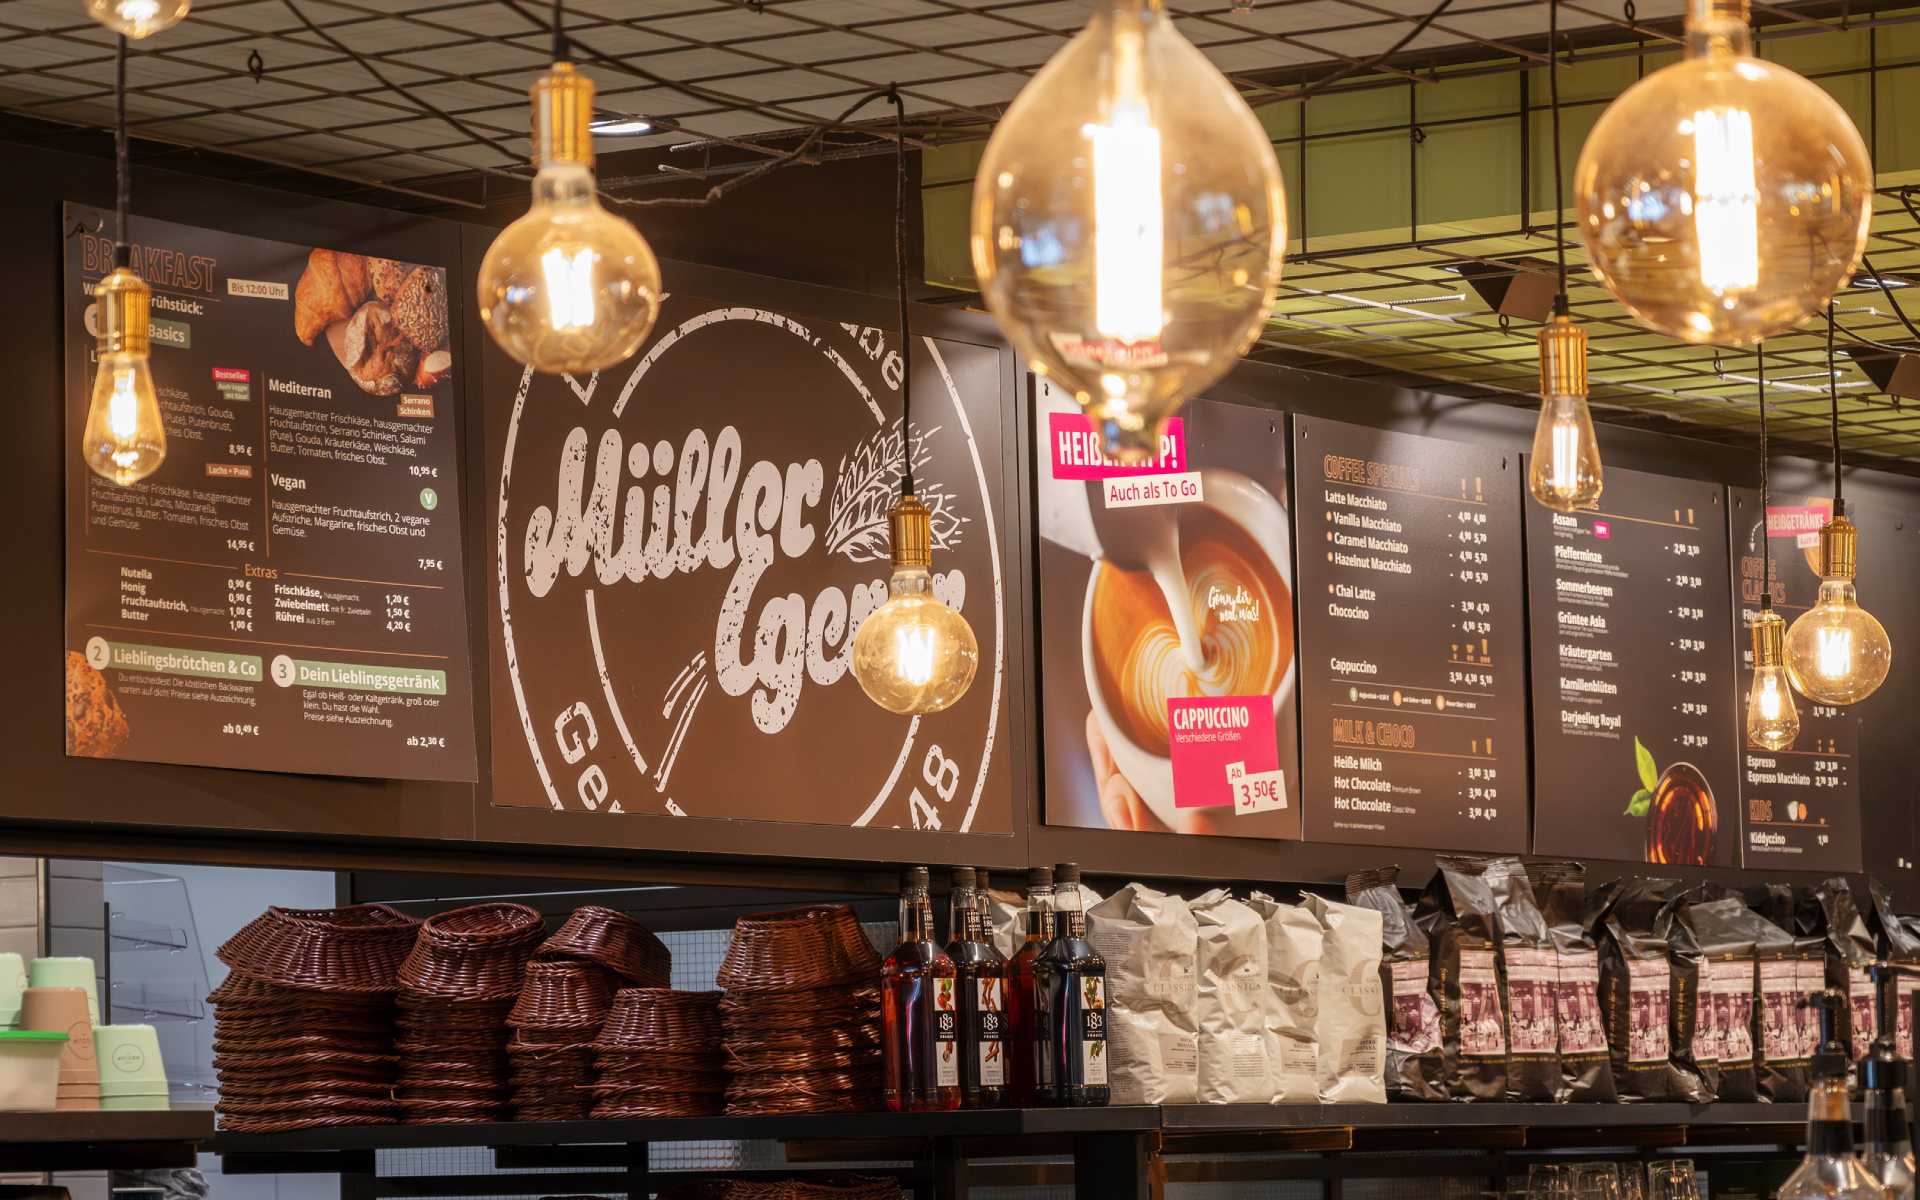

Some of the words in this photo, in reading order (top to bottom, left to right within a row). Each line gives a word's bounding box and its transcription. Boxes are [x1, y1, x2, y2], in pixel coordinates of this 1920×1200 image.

[80, 234, 216, 293] BRAKFAST
[232, 282, 244, 292] Bis
[246, 284, 267, 295] 12:00
[269, 287, 286, 296] Uhr
[149, 296, 204, 316] rühstück:
[148, 324, 185, 342] Basics
[268, 379, 332, 400] Mediterran
[403, 396, 431, 405] Serrano
[269, 405, 329, 423] Hausgemachter
[330, 412, 371, 427] Frischkäse,
[374, 416, 434, 434] hausgemachter
[400, 407, 432, 416] Schinken
[269, 418, 328, 434] Fruchtaufstrich,
[330, 424, 360, 438] Serrano
[362, 428, 398, 444] Schinken,
[400, 432, 426, 446] Salami
[229, 444, 246, 454] 8,95
[246, 446, 252, 456] €
[324, 436, 372, 452] Kräuterkäse,
[374, 442, 417, 458] Weichkäse,
[334, 450, 365, 464] frisches
[366, 454, 388, 466] Obst.
[409, 466, 430, 478] 10,95
[432, 467, 438, 478] €
[1324, 454, 1365, 484] COFFEE
[271, 474, 306, 492] Vegan
[1110, 483, 1140, 502] Auch
[1143, 482, 1160, 500] als
[1162, 481, 1178, 498] To
[1180, 480, 1197, 496] Go
[424, 493, 434, 504] V
[1325, 490, 1346, 504] Latte
[1347, 493, 1388, 511] Macchiato
[272, 498, 331, 516] hausgemachter
[332, 506, 393, 522] Fruchtaufstrich,
[394, 512, 400, 522] 2
[402, 515, 431, 528] vegane
[524, 425, 824, 597] Müller
[1553, 512, 1578, 528] Assam
[272, 512, 313, 526] Aufstriche,
[314, 518, 356, 532] Margarine,
[356, 522, 388, 534] frisches
[388, 524, 408, 536] Obst
[409, 526, 426, 538] und
[1334, 512, 1360, 526] Vanilla
[1362, 514, 1402, 533] Macchiato
[226, 539, 247, 550] 14,95
[248, 541, 255, 552] €
[1334, 532, 1367, 548] Caramel
[1368, 536, 1408, 554] Macchiato
[1335, 552, 1370, 568] Hazelnut
[1371, 556, 1412, 574] Macchiato
[1554, 545, 1602, 564] Pfefferminze
[244, 564, 278, 578] Extras
[418, 558, 435, 570] 7,95
[436, 560, 444, 570] €
[120, 567, 152, 580] Nutella
[246, 581, 252, 592] €
[1556, 578, 1613, 597] Sommerbeeren
[120, 581, 146, 596] Honig
[246, 594, 252, 604] €
[274, 584, 322, 600] Frischkäse,
[386, 594, 402, 606] 1,20
[403, 596, 409, 606] €
[1336, 584, 1354, 598] Chai
[1355, 586, 1376, 600] Latte
[121, 595, 189, 612] Fruchtaufstrich,
[246, 608, 252, 618] €
[274, 598, 330, 612] Zwiebelmett
[386, 608, 403, 619] 1,50
[404, 610, 410, 619] €
[1328, 603, 1370, 620] Chococino
[121, 608, 150, 622] Butter
[247, 622, 252, 632] €
[276, 612, 304, 624] Rührei
[386, 622, 404, 632] 4,20
[405, 622, 411, 632] €
[1558, 610, 1589, 627] Grüntee
[1590, 614, 1606, 628] Asia
[94, 646, 102, 662] 2
[114, 648, 226, 673] Lieblingsbrötchen
[228, 660, 238, 674] &
[240, 661, 256, 676] Co
[1559, 644, 1612, 662] Kräutergarten
[1330, 657, 1378, 674] Cappuccino
[173, 678, 184, 688] Die
[218, 682, 254, 694] Backwaren
[278, 664, 287, 679] 3
[300, 666, 330, 682] Dein
[332, 668, 440, 690] Lieblingsgetränk
[1560, 676, 1618, 695] Kamillenblüten
[303, 690, 317, 700] Egal
[318, 692, 327, 700] ob
[348, 693, 364, 702] oder
[424, 698, 440, 707] oder
[304, 712, 325, 722] Preise
[326, 714, 344, 723] siehe
[322, 703, 332, 712] Du
[333, 704, 348, 712] hast
[350, 704, 360, 714] die
[361, 705, 380, 714] Wahl.
[1174, 706, 1249, 730] CAPPUCCINO
[1562, 710, 1600, 728] Darjeeling
[1601, 714, 1621, 730] Royal
[222, 724, 234, 734] ab
[236, 724, 252, 736] 0,49
[253, 726, 259, 736] €
[1175, 731, 1216, 744] Verschiedene
[1218, 730, 1242, 742] Größen
[1332, 718, 1364, 744] MILK
[1366, 720, 1376, 745] &
[1376, 722, 1416, 749] CHOCO
[406, 736, 418, 746] ab
[420, 737, 437, 748] 2,30
[438, 738, 445, 748] €
[1334, 756, 1358, 770] Heiße
[1360, 758, 1382, 772] Milch
[1746, 754, 1776, 770] Espresso
[1230, 768, 1242, 778] Ab
[1748, 770, 1776, 786] Espresso
[1777, 772, 1811, 786] Macchiato
[1334, 776, 1350, 790] Hot
[1351, 777, 1392, 792] Chocolate
[1334, 796, 1350, 810] Hot
[1351, 797, 1392, 812] Chocolate
[1749, 799, 1773, 822] KIDS
[1750, 831, 1786, 846] Kiddyccino
